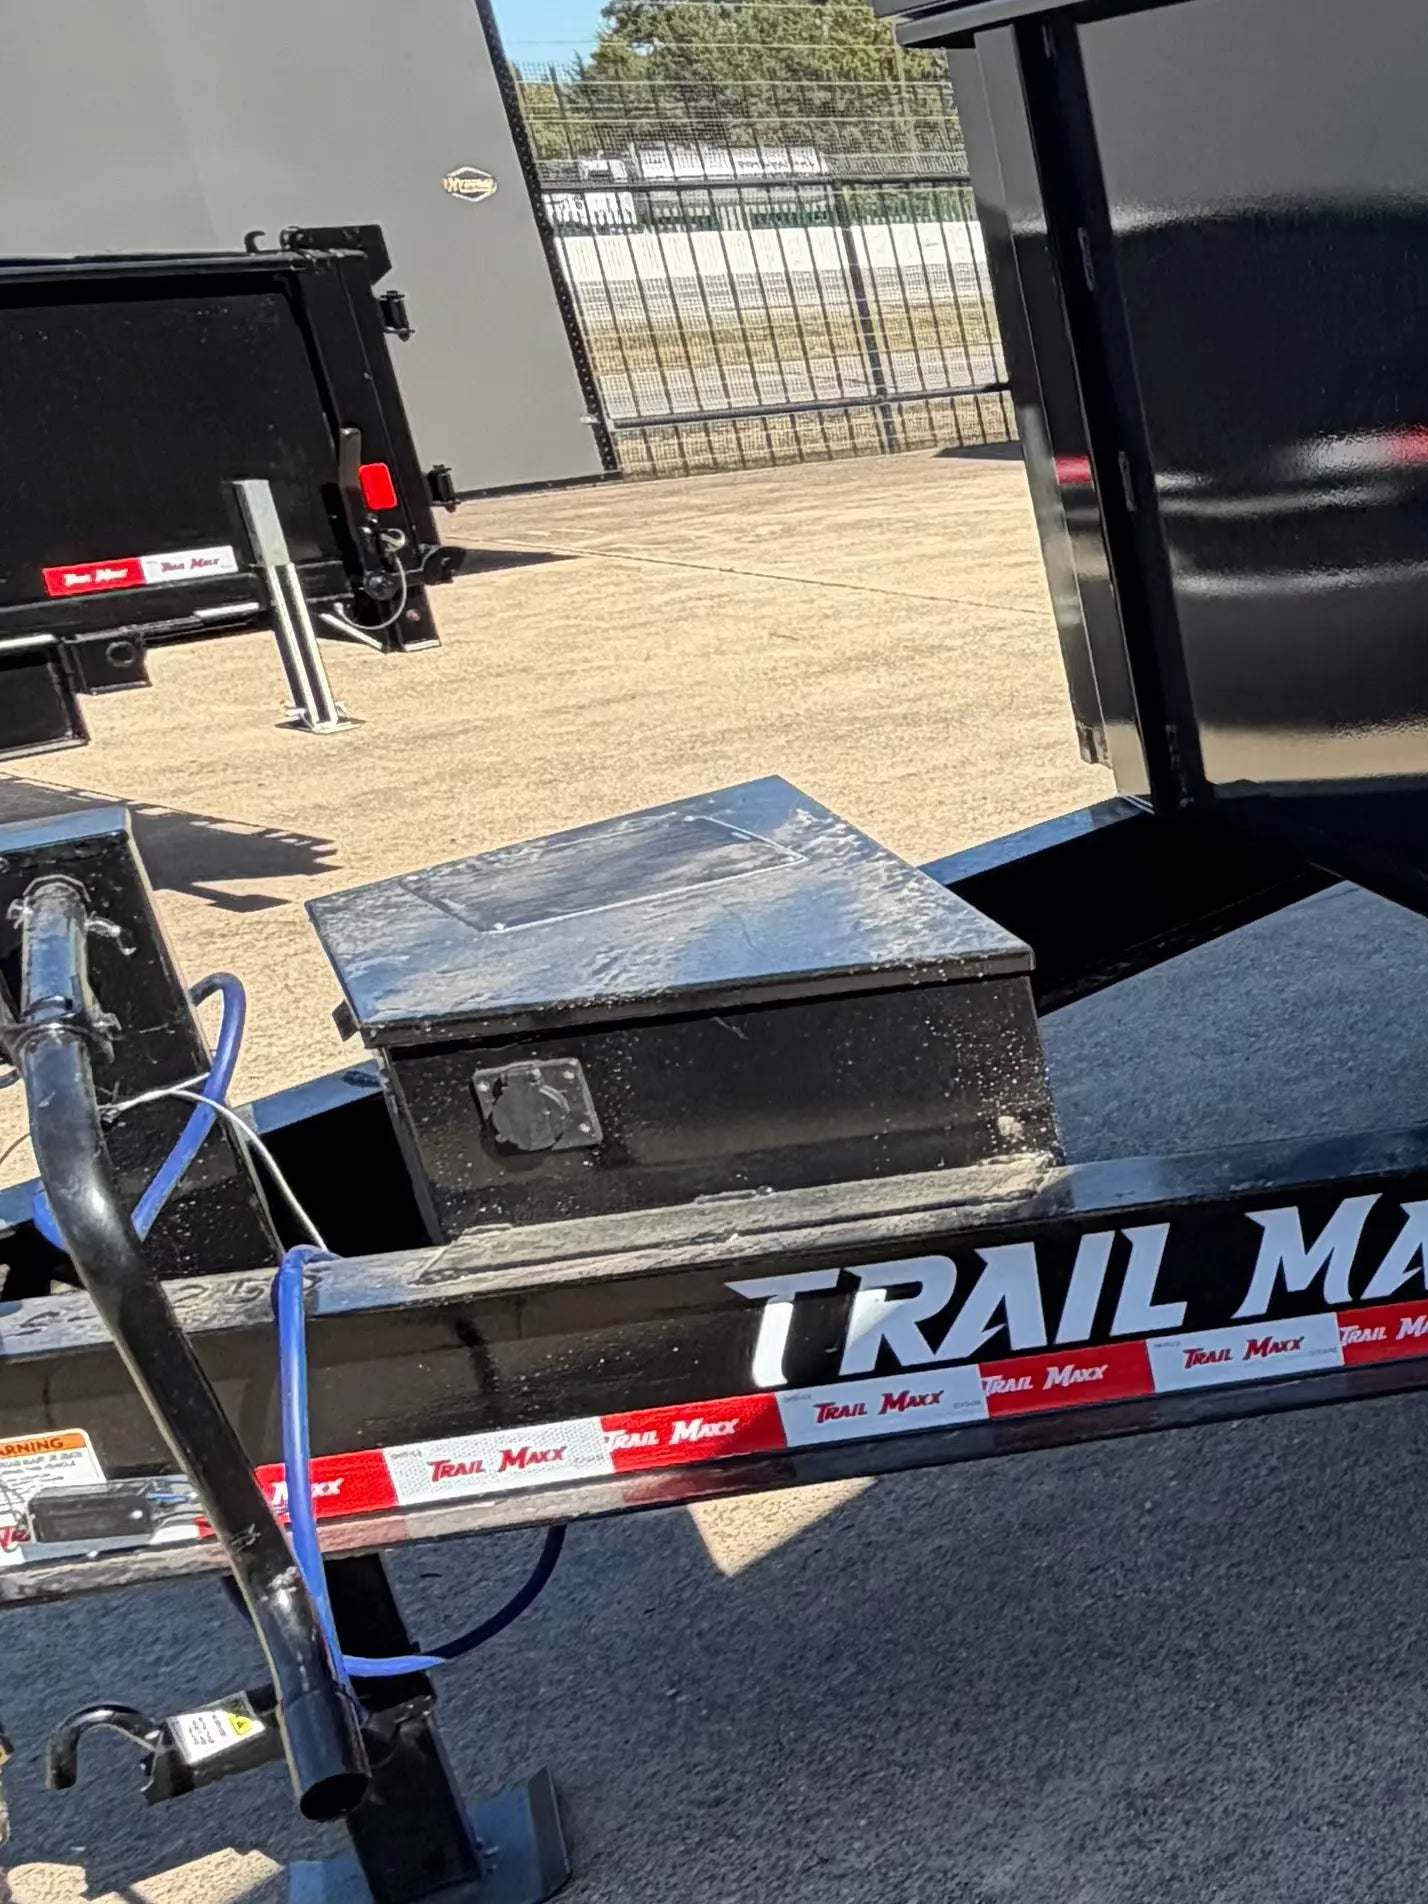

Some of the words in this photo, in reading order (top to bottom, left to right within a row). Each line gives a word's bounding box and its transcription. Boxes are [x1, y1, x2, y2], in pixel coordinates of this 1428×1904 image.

[725, 1222, 1188, 1389] TRAIL
[1341, 1324, 1388, 1346] TRAIL
[1183, 1348, 1234, 1369] TRAIL
[1242, 1336, 1305, 1361] MAXX
[982, 1374, 1034, 1396] TRAIL
[1042, 1364, 1109, 1390] MAXX
[814, 1402, 868, 1424] TRAIL
[878, 1390, 945, 1415] MAXX
[602, 1429, 660, 1451] TRAIL
[669, 1418, 740, 1445] MAXX
[427, 1458, 486, 1482] TRAIL
[498, 1446, 568, 1472] MAXX
[271, 1477, 345, 1505] MXX
